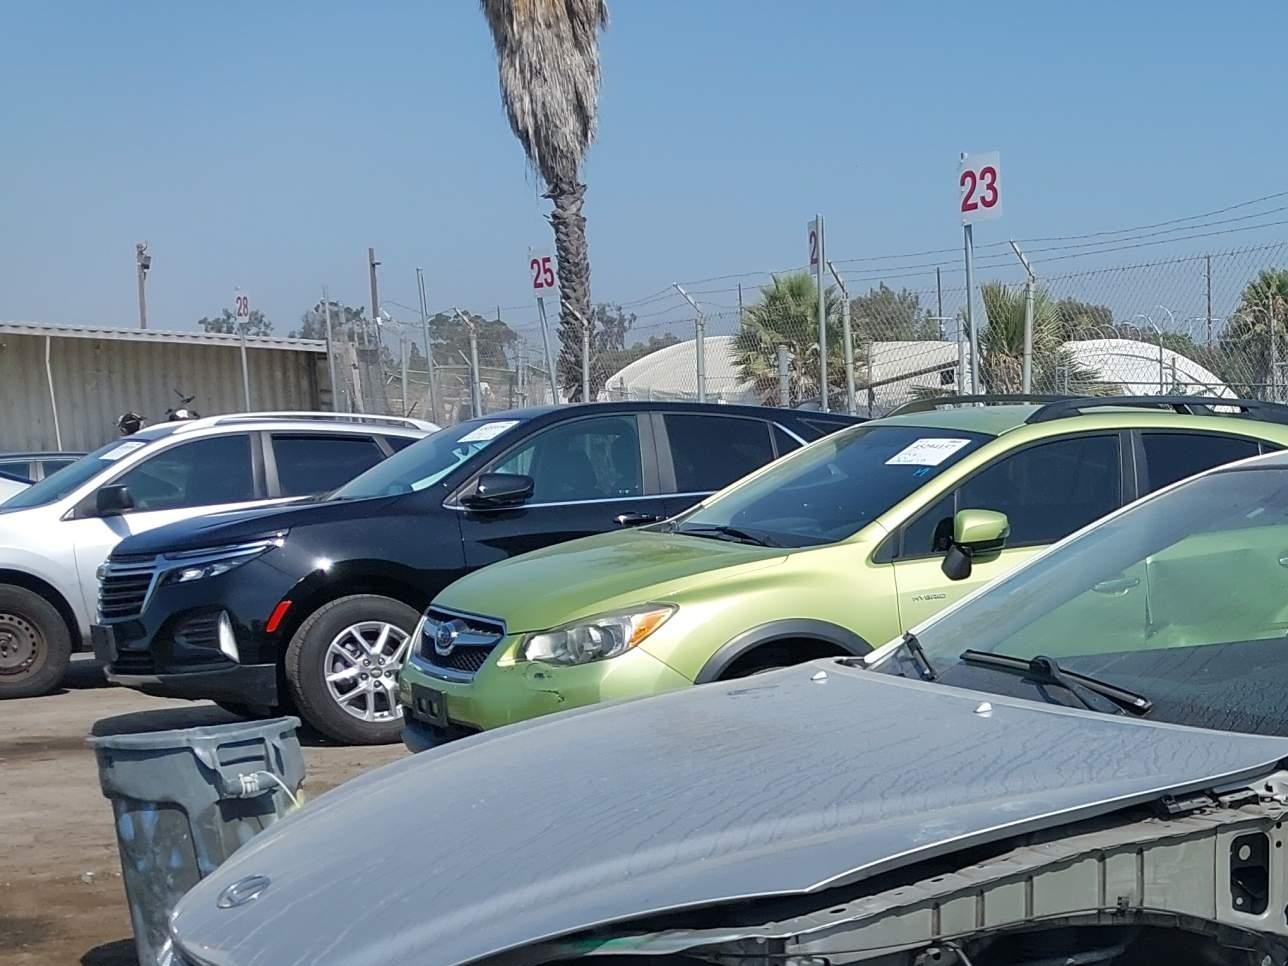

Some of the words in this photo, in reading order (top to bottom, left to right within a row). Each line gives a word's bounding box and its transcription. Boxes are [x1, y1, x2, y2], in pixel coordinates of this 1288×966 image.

[960, 166, 998, 212] 23
[810, 231, 819, 264] 2
[530, 257, 554, 288] 25
[236, 296, 248, 317] 28
